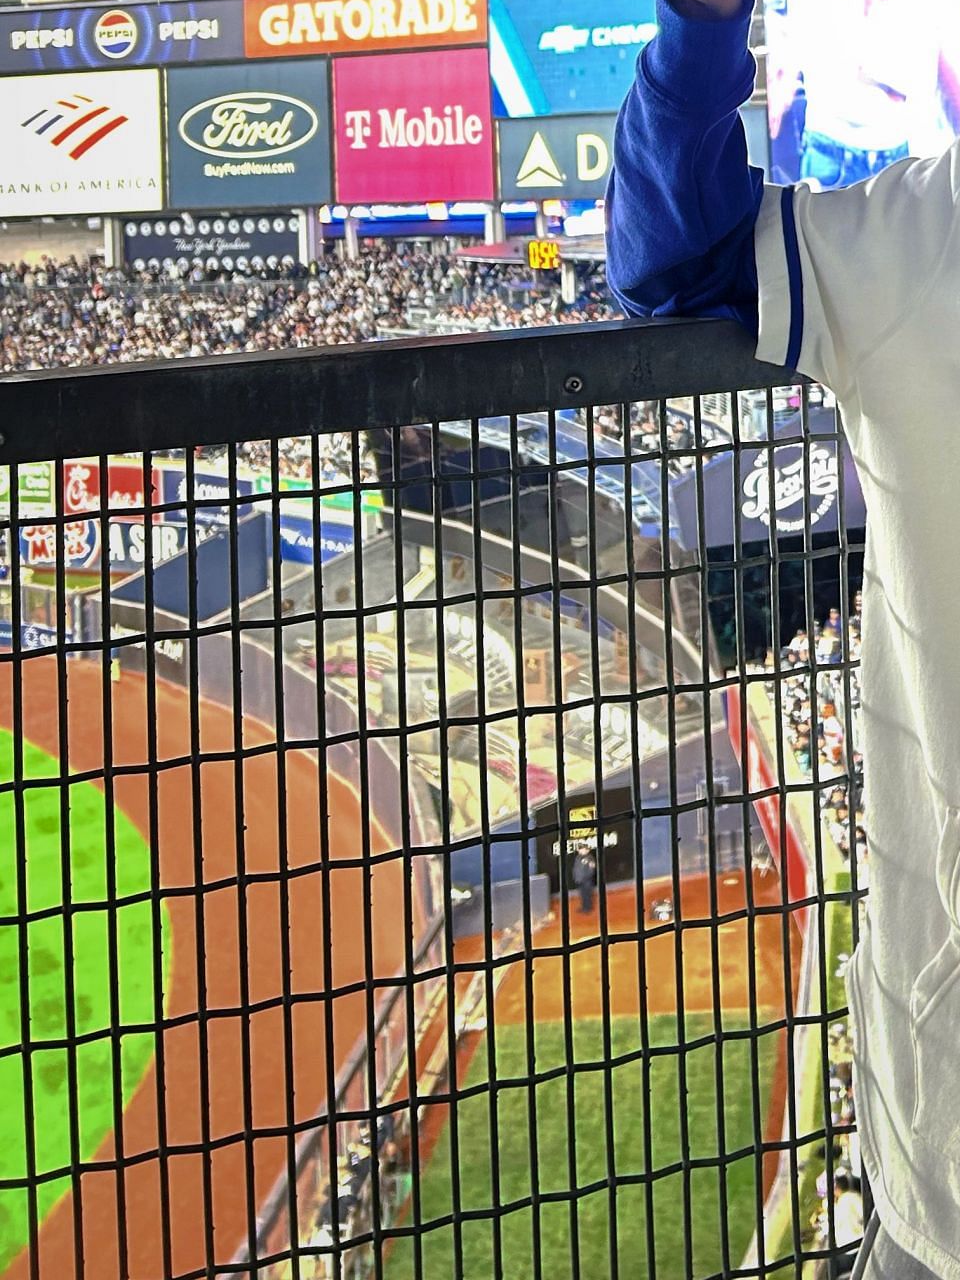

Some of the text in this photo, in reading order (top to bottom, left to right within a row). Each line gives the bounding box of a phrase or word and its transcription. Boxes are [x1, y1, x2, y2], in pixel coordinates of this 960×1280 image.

[11, 28, 74, 50] PEPSI
[99, 30, 134, 39] PEPSI
[159, 19, 219, 41] PEPSI
[203, 102, 294, 148] Ford
[204, 162, 295, 178] BuyFordNow.com
[78, 177, 157, 192] AMERICA
